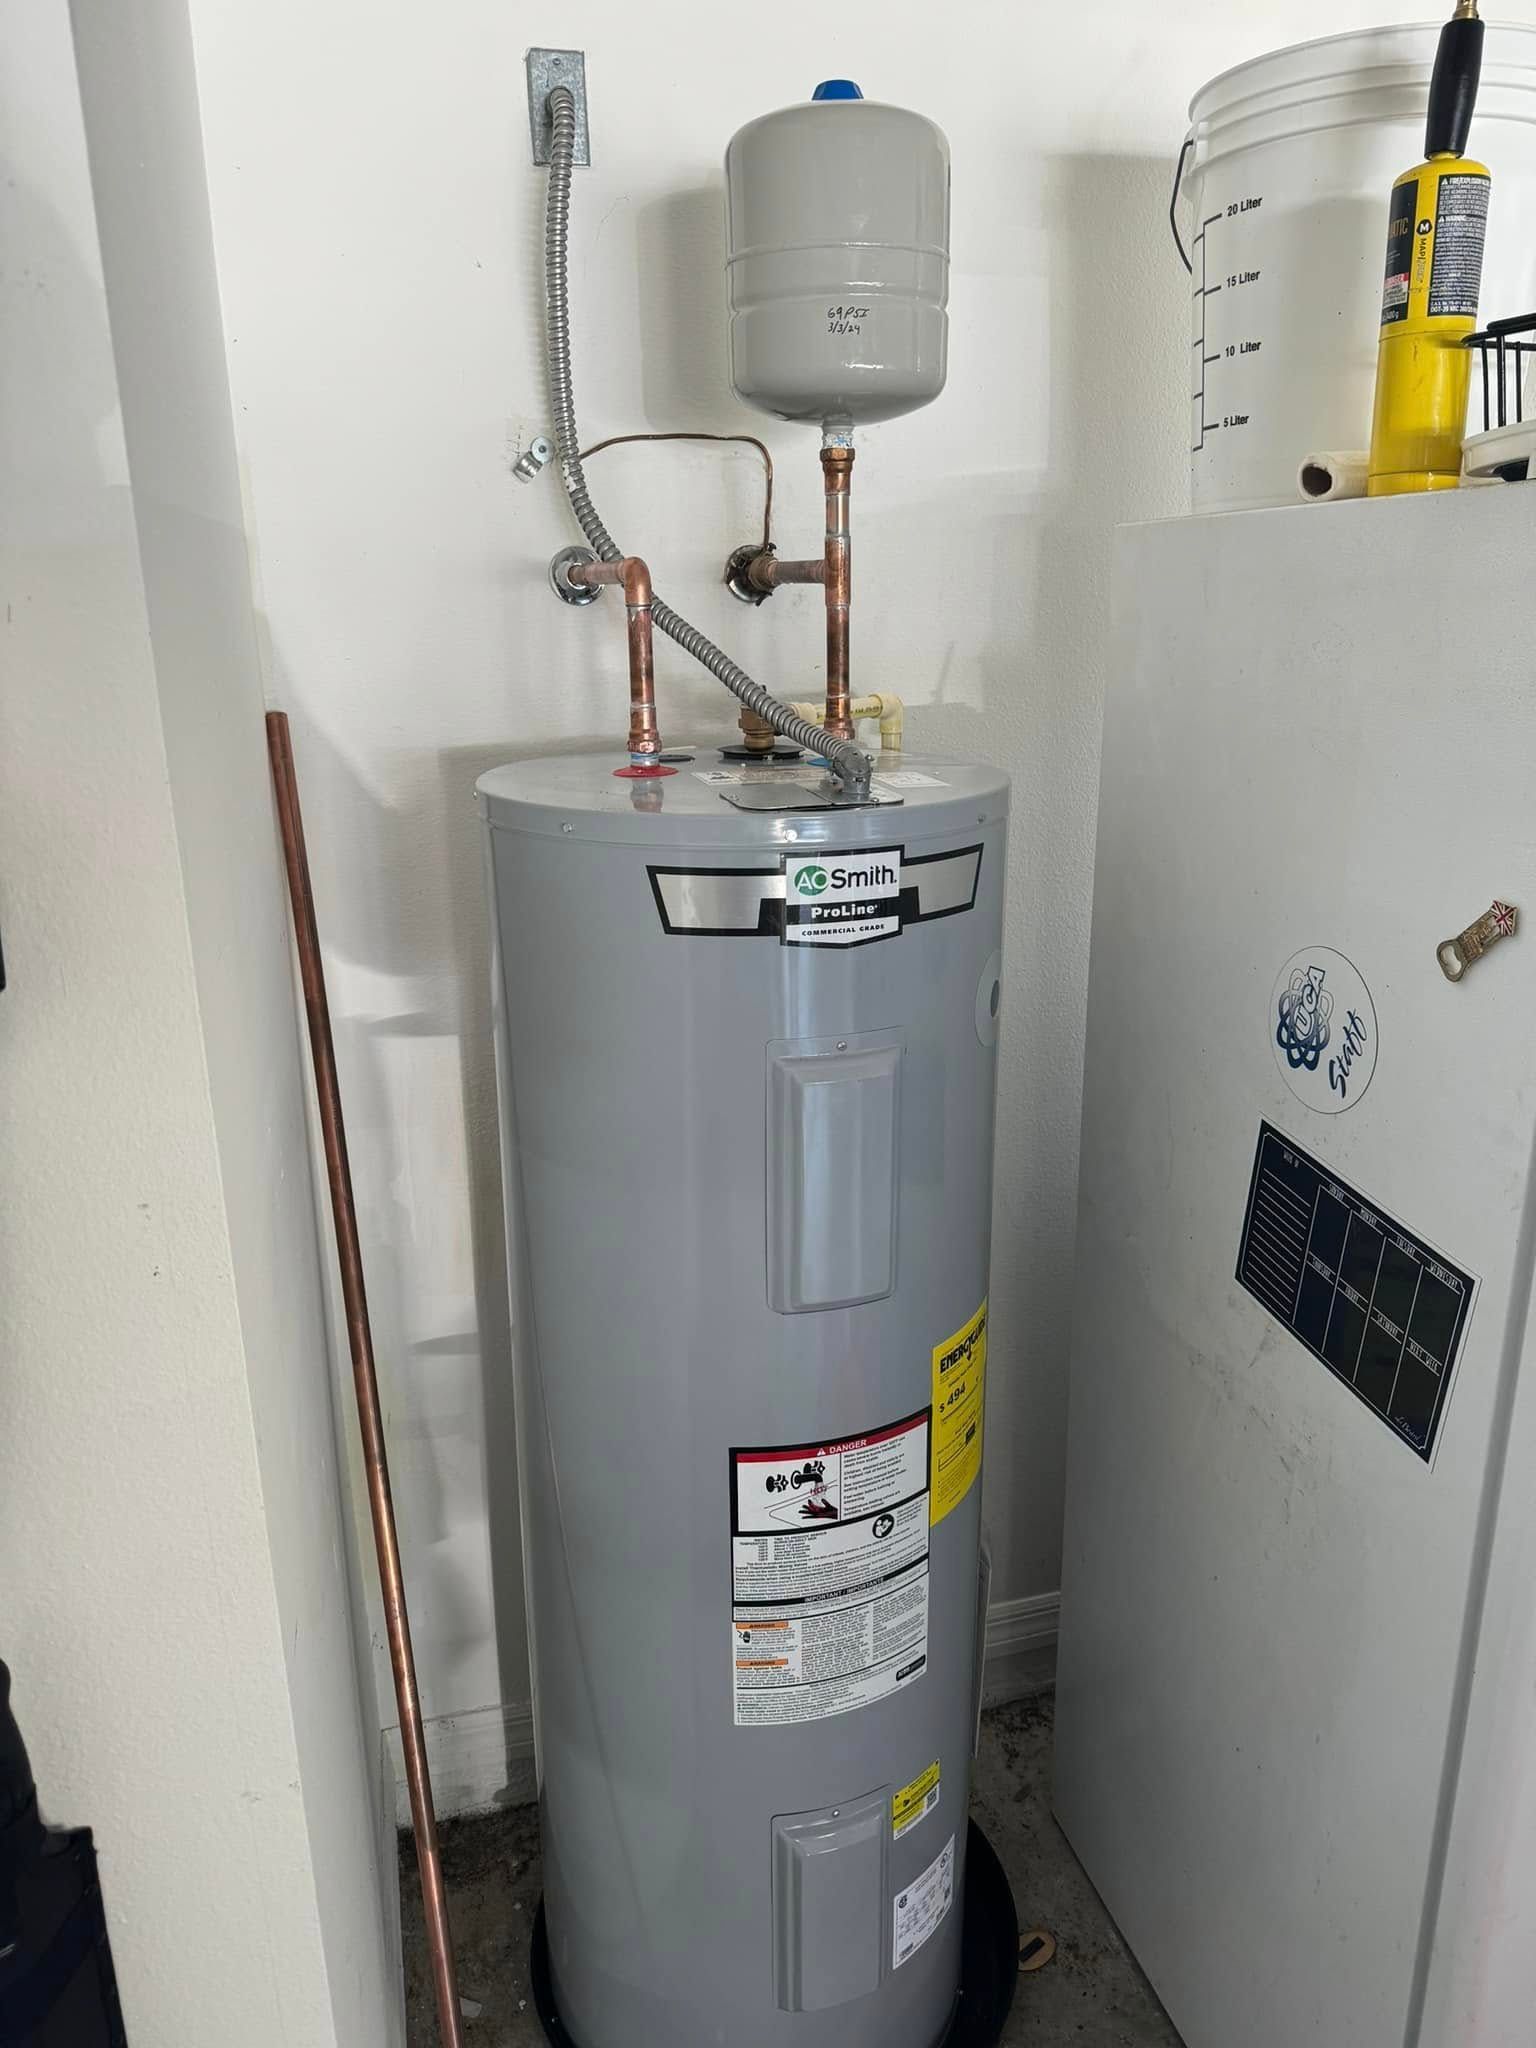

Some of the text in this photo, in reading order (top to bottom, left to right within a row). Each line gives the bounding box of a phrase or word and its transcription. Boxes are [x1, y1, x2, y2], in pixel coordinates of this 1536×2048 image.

[1227, 197, 1263, 217] 20 Liter
[1226, 271, 1261, 288] 15 Liter
[1225, 341, 1262, 357] 10 Liter
[1223, 415, 1249, 427] 5 Liter
[802, 924, 885, 936] COMMERCIAL GRADE
[1293, 965, 1326, 1042] UCA
[1329, 1008, 1368, 1099] Staff
[947, 1382, 966, 1406] 494
[829, 1439, 867, 1454] DANGER
